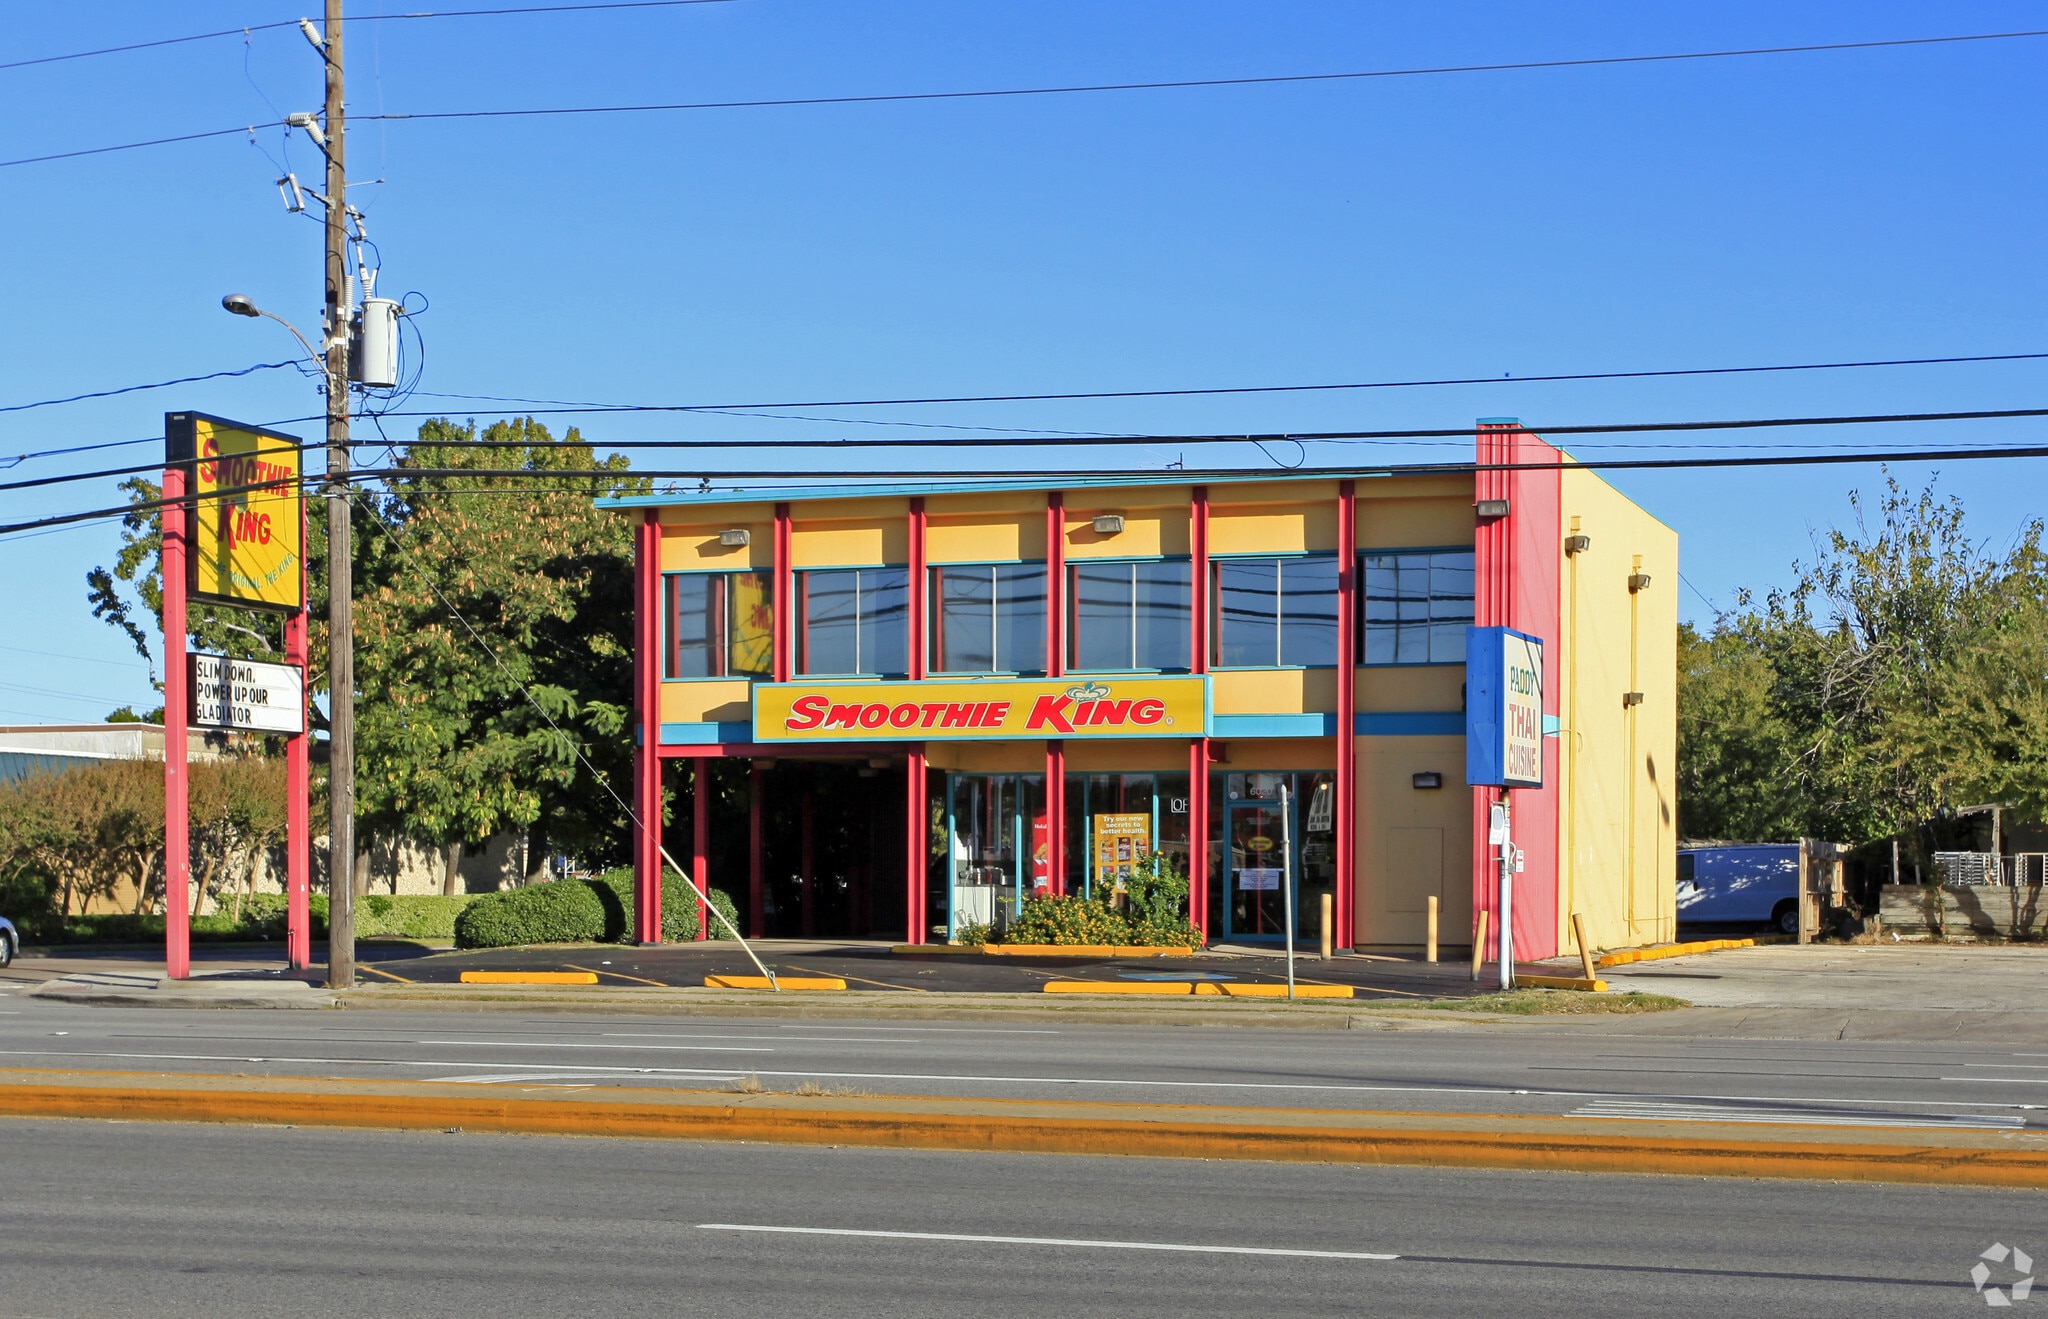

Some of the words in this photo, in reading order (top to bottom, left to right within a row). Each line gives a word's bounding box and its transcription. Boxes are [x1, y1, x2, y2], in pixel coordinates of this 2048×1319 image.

[200, 438, 292, 498] SMOOTHIE
[217, 497, 271, 550] KING
[197, 661, 222, 680] SLIM
[1510, 665, 1535, 697] PADDY
[197, 682, 233, 702] POWER
[234, 686, 248, 702] UP
[249, 687, 269, 705] OUR
[196, 703, 253, 725] GLADIATOR
[785, 694, 1012, 731] SMOOTHIE
[1024, 692, 1166, 734] KING
[1508, 703, 1536, 741] THAI
[1508, 743, 1536, 778] CUISINE
[1102, 815, 1114, 823] Try
